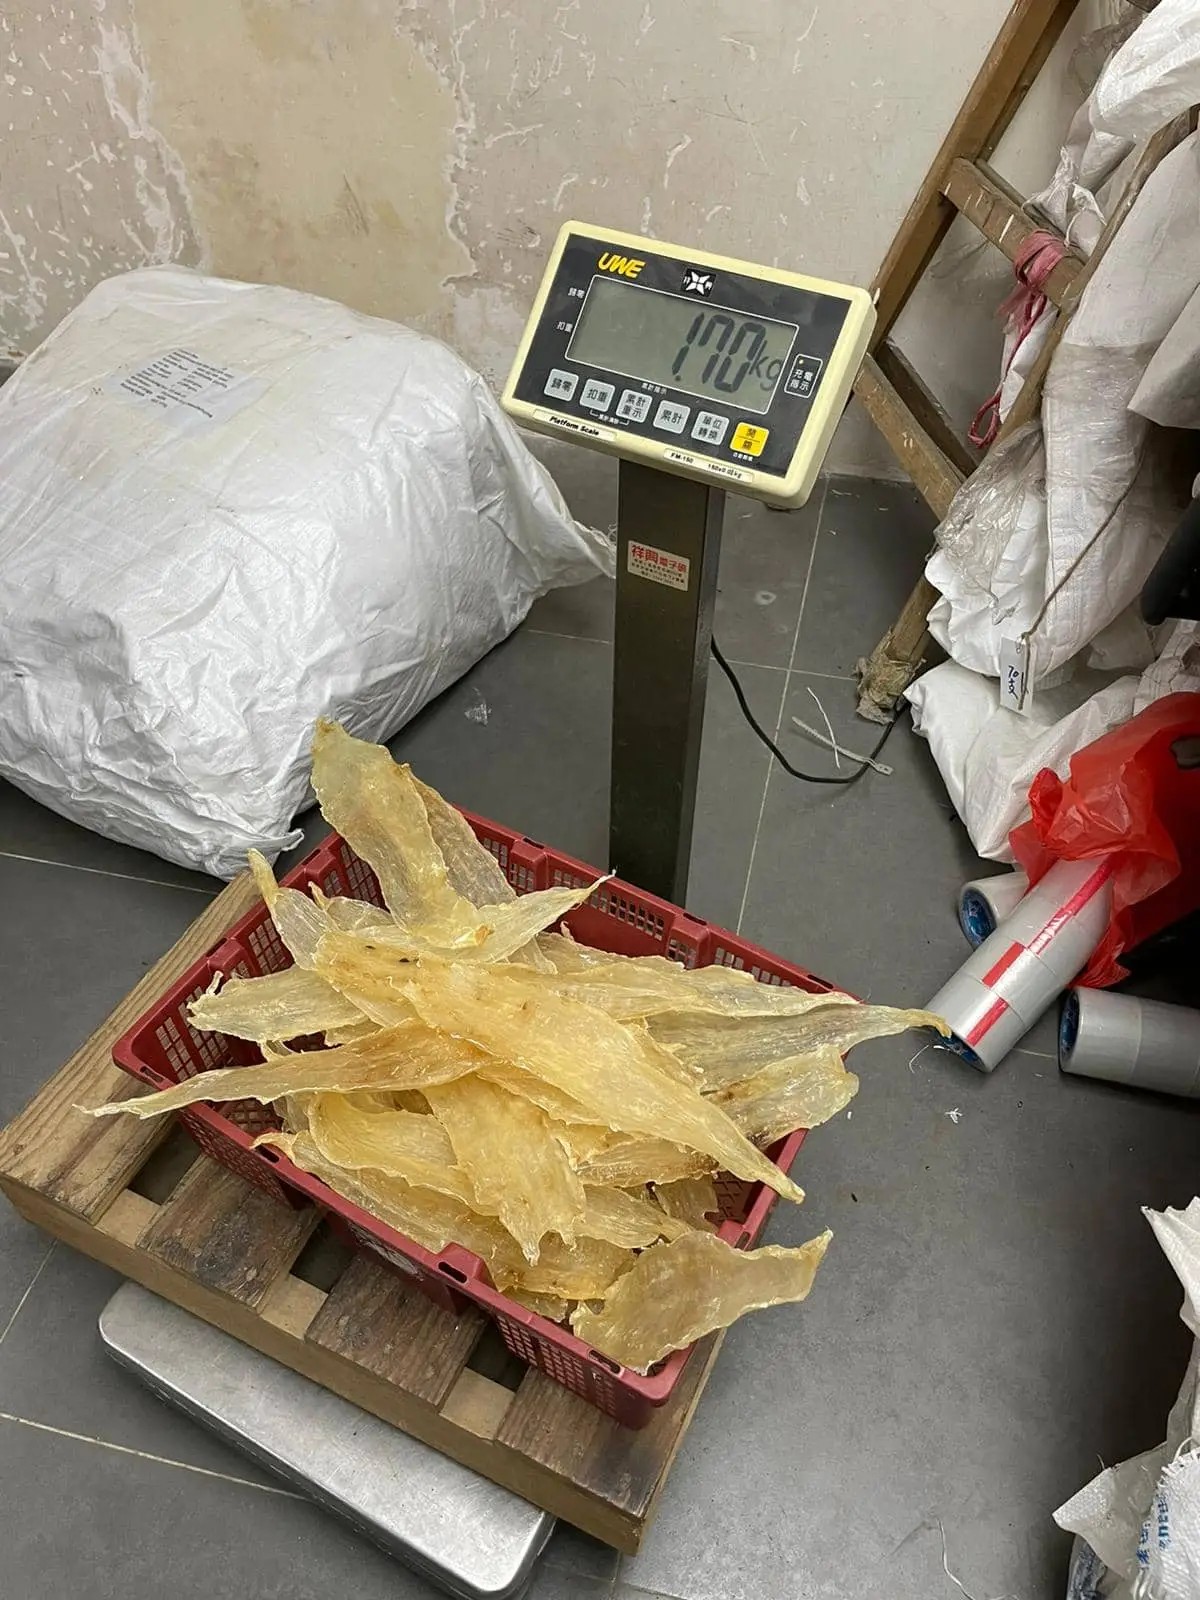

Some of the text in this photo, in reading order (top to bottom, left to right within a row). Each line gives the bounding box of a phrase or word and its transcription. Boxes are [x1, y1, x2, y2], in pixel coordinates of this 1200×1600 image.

[597, 252, 646, 279] UWE
[749, 340, 783, 391] kg
[586, 388, 608, 403] 扣重
[549, 415, 600, 436] Platform Scale
[660, 409, 682, 424] 累計
